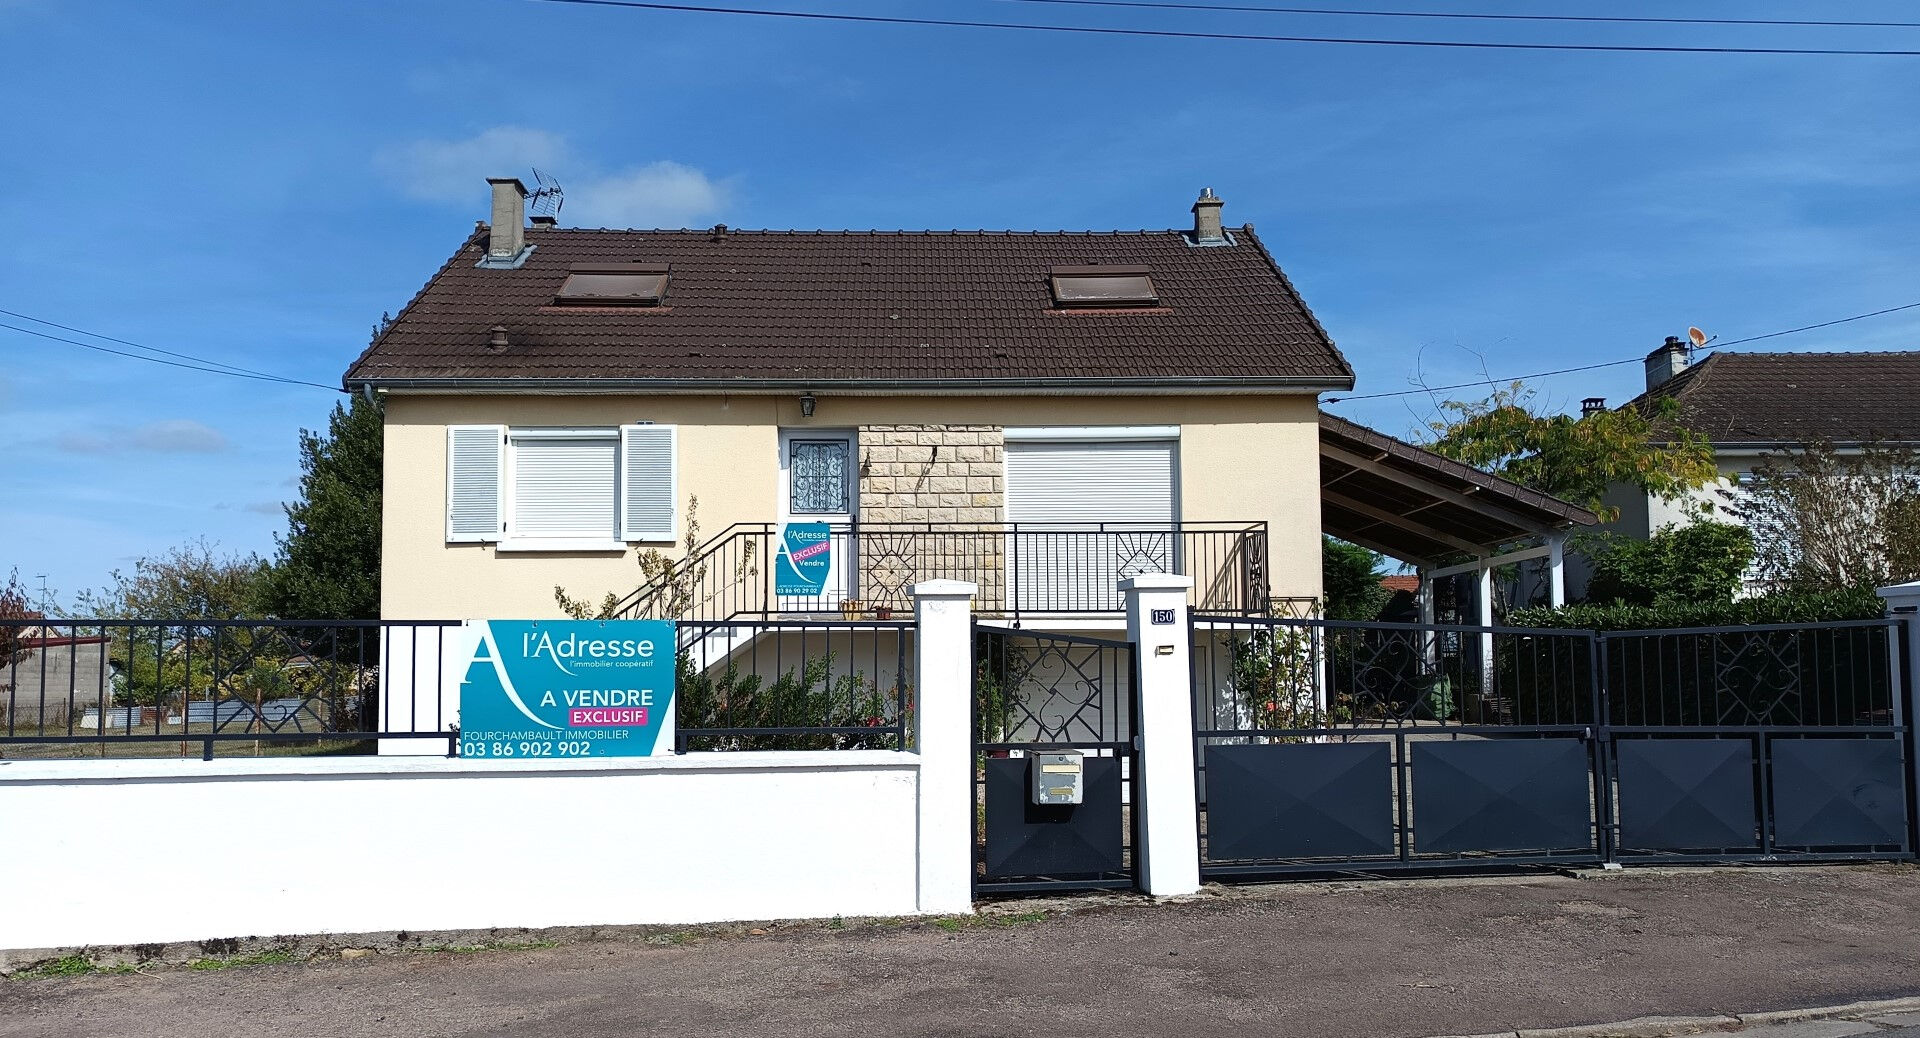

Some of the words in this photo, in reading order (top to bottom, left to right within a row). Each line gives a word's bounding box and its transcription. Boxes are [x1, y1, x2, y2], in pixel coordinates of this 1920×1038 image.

[787, 530, 827, 540] l'Adresse
[793, 542, 828, 561] EXCLUSIF
[1154, 611, 1173, 622] 150
[523, 630, 654, 668] l'Adresse
[569, 660, 614, 668] l'immobilier
[615, 660, 654, 669] coopératif
[540, 690, 557, 707] A
[563, 689, 654, 707] VENDRE
[573, 710, 644, 724] EXCLUSIF
[464, 731, 562, 741] FOURCHAMBAULT
[565, 730, 629, 740] IMMOBILIER
[464, 742, 486, 756] 03
[492, 742, 514, 756] 86
[519, 742, 552, 756] 902
[558, 741, 591, 756] 902
